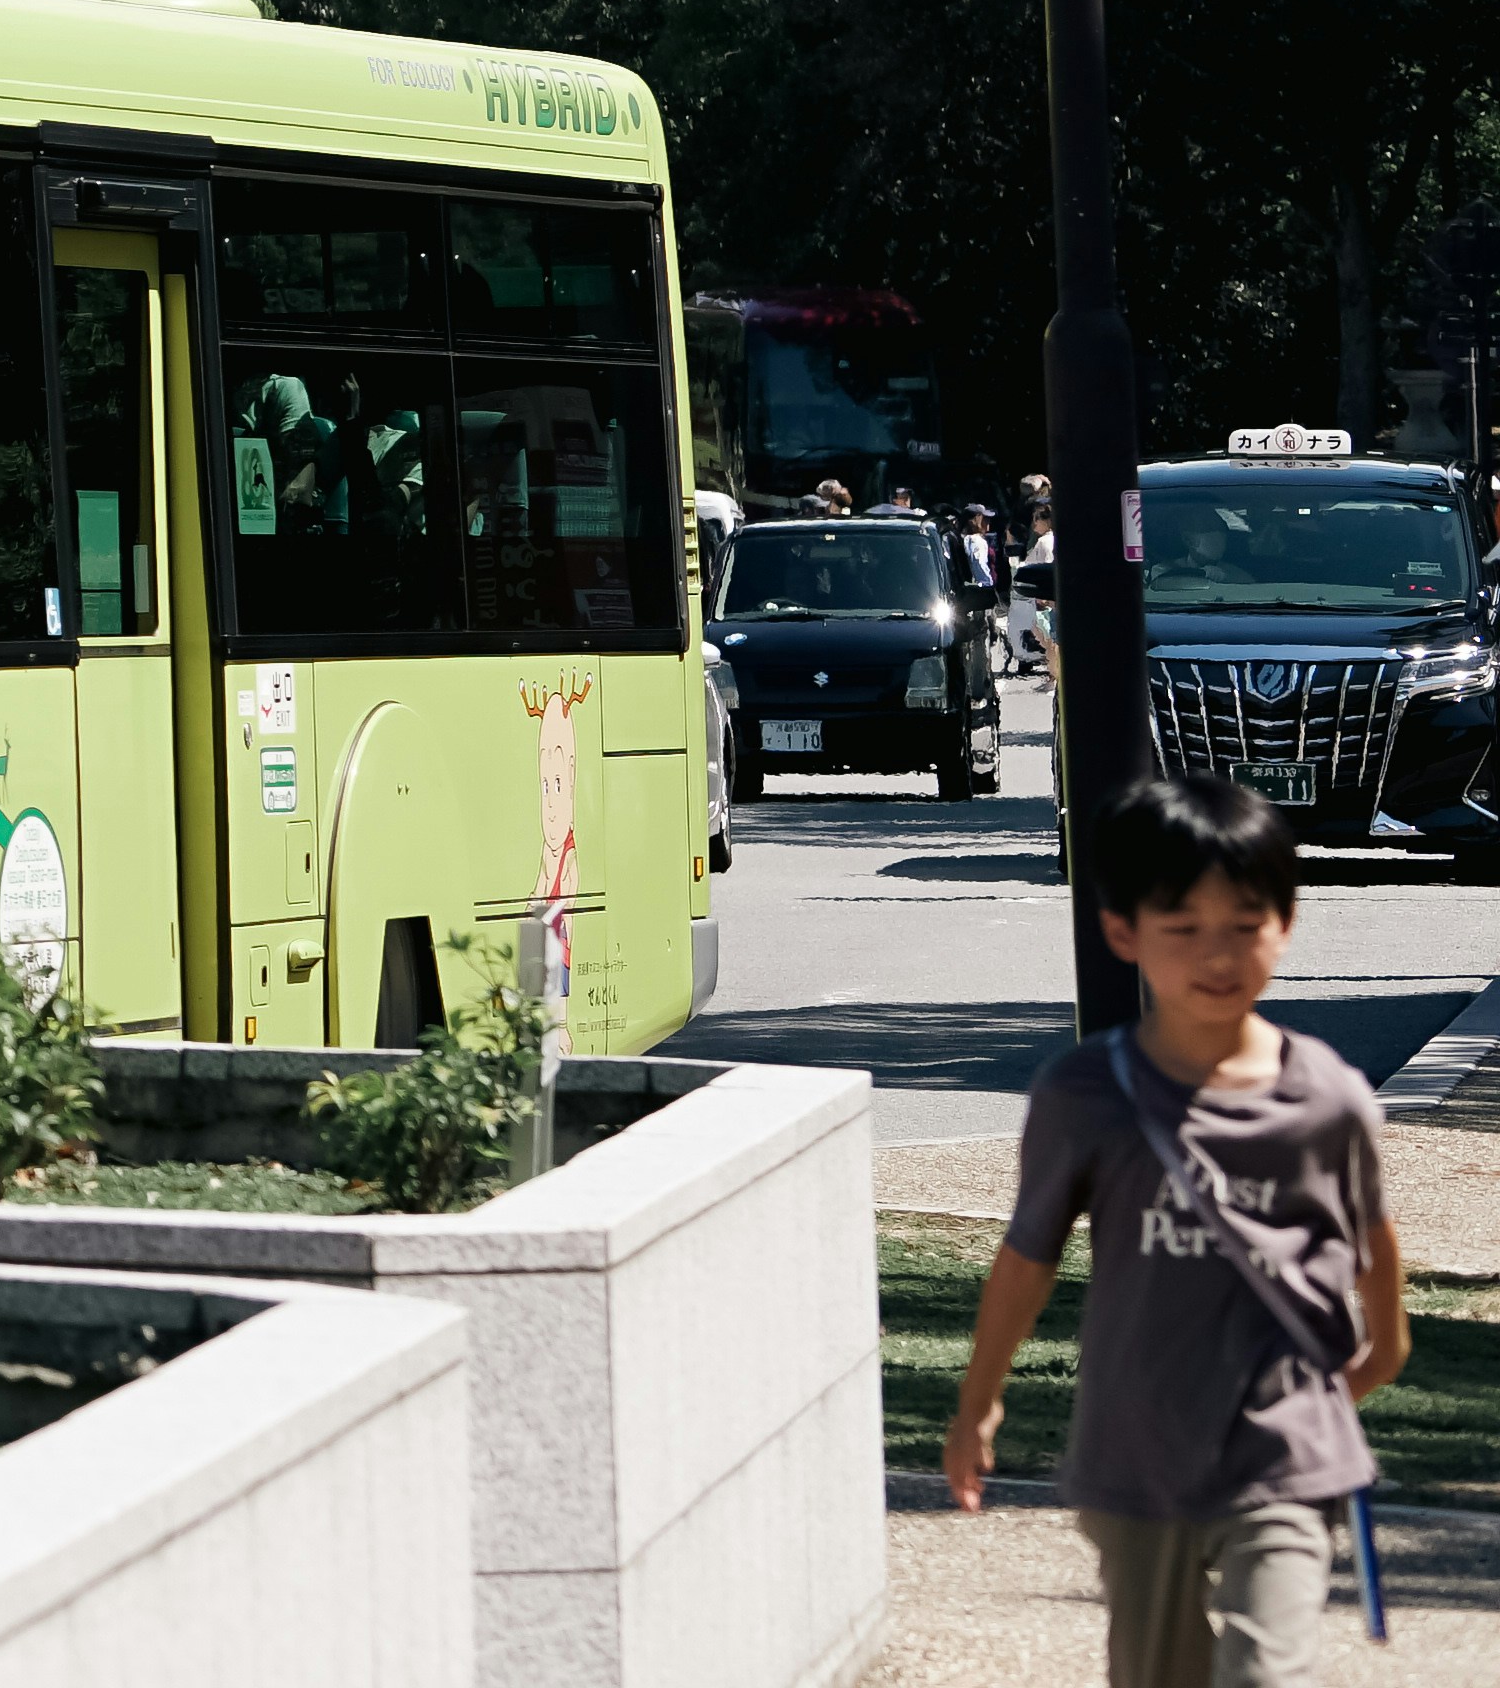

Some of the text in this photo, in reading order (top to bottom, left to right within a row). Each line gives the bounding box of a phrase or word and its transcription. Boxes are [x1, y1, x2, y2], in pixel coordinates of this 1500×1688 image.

[367, 56, 457, 92] FOR ECOLOGY
[476, 58, 618, 136] HYBRID
[1238, 435, 1271, 450] カイ
[1307, 435, 1341, 450] ナラ
[273, 672, 292, 703] 出口
